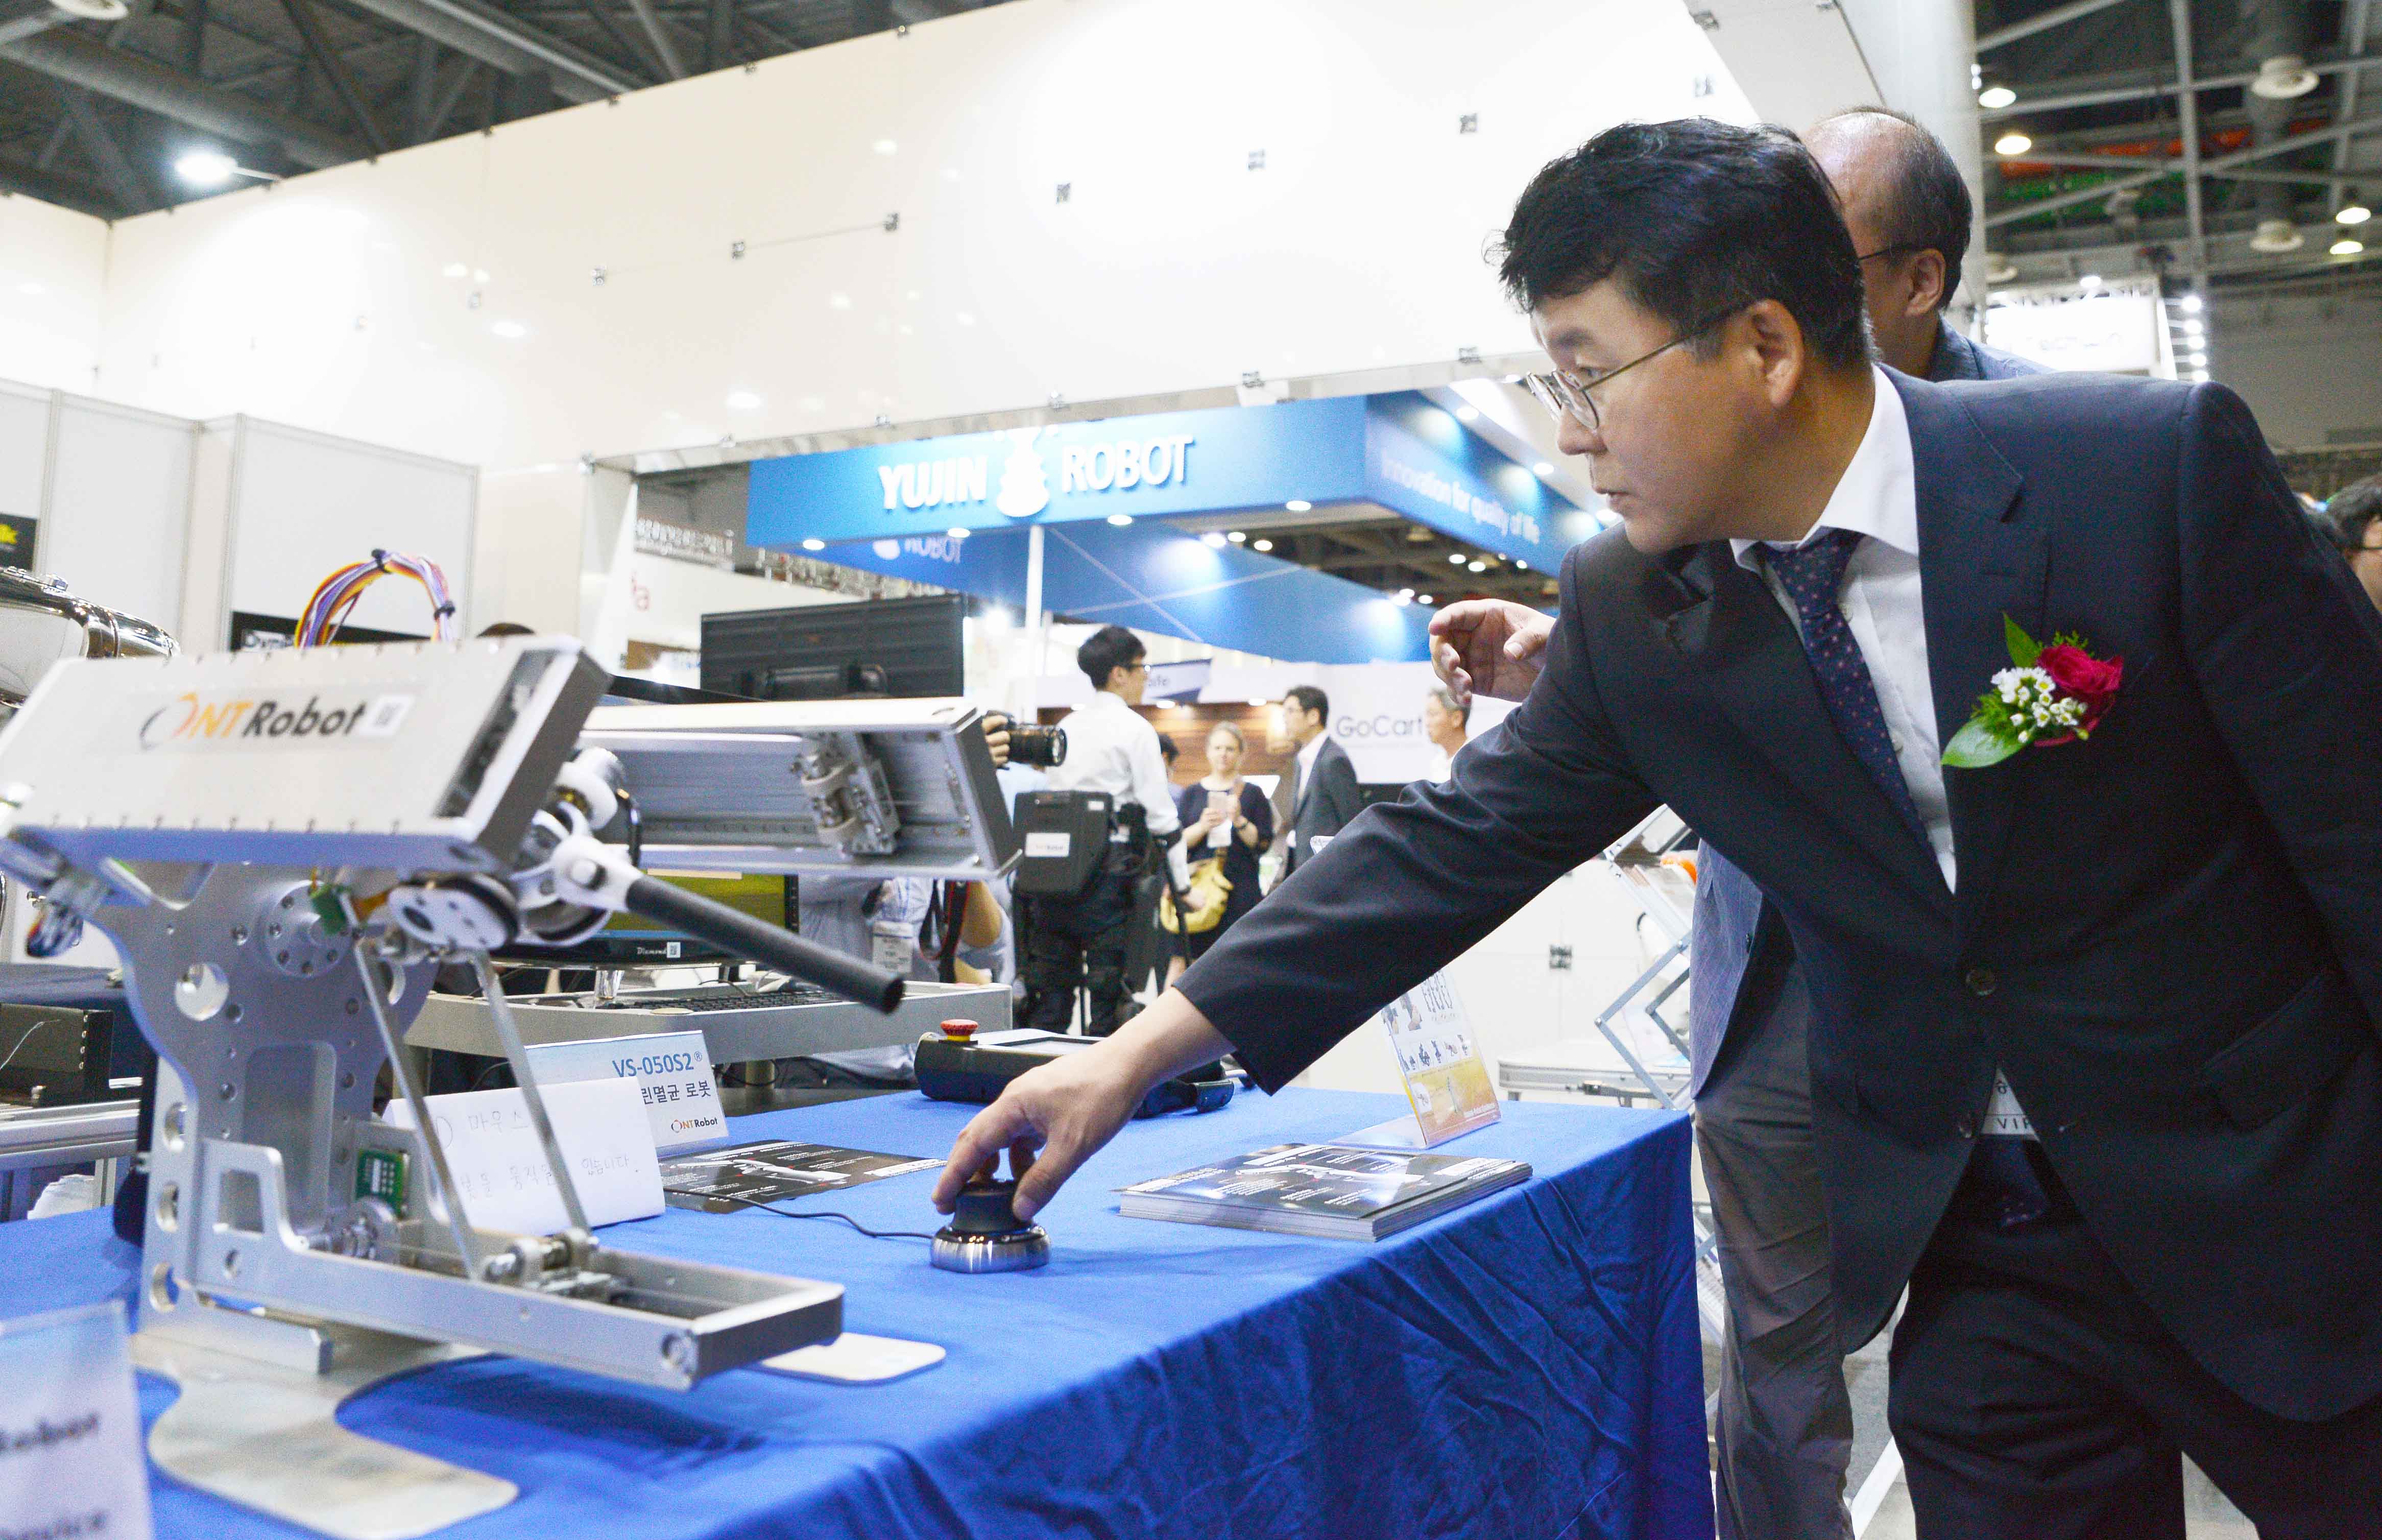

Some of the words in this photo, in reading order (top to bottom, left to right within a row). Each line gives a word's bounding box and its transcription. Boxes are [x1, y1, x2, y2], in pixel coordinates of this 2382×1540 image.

[879, 454, 989, 510] YUJIN
[1062, 436, 1193, 492] ROBOT
[1336, 714, 1423, 738] GoCart
[686, 1079, 711, 1098] 로봇
